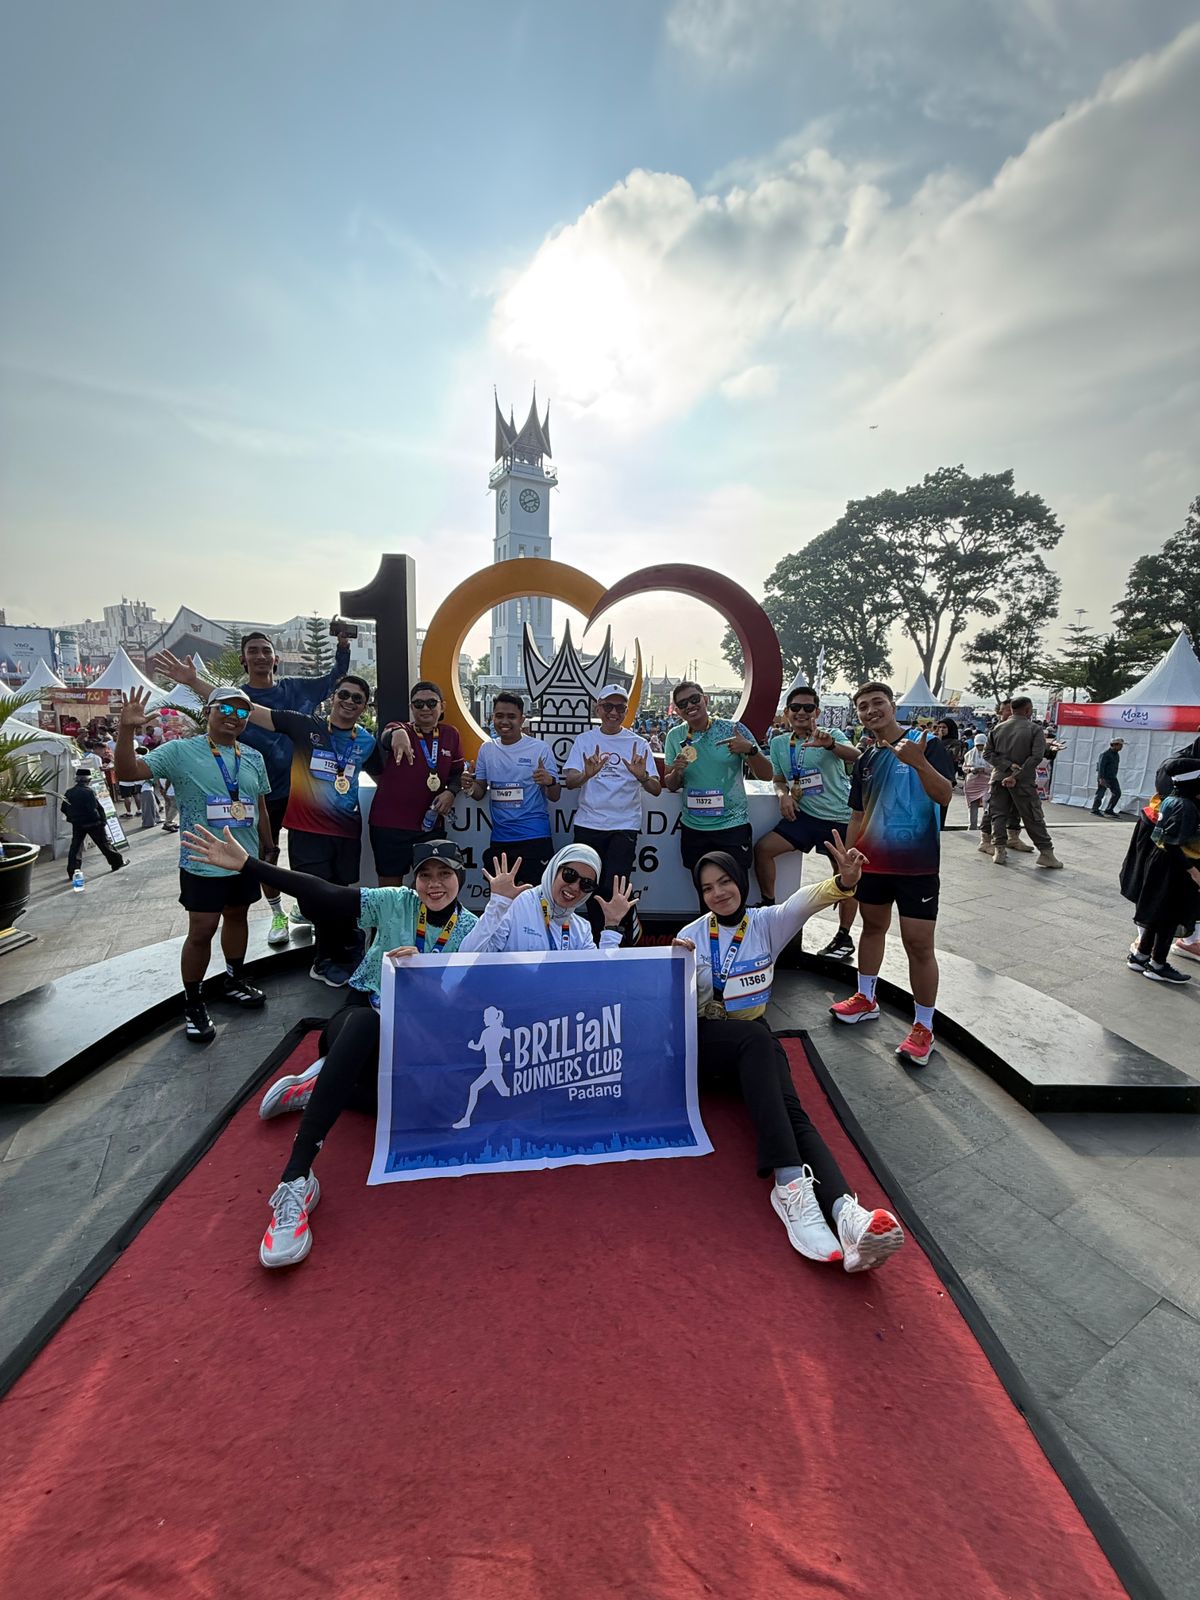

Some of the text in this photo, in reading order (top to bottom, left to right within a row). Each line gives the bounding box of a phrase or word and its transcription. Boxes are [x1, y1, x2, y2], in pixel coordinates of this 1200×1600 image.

[1121, 708, 1149, 721] Mozy
[739, 973, 766, 987] 11368
[513, 1047, 622, 1096] RUNNERS CLUB
[568, 1084, 622, 1101] Padang
